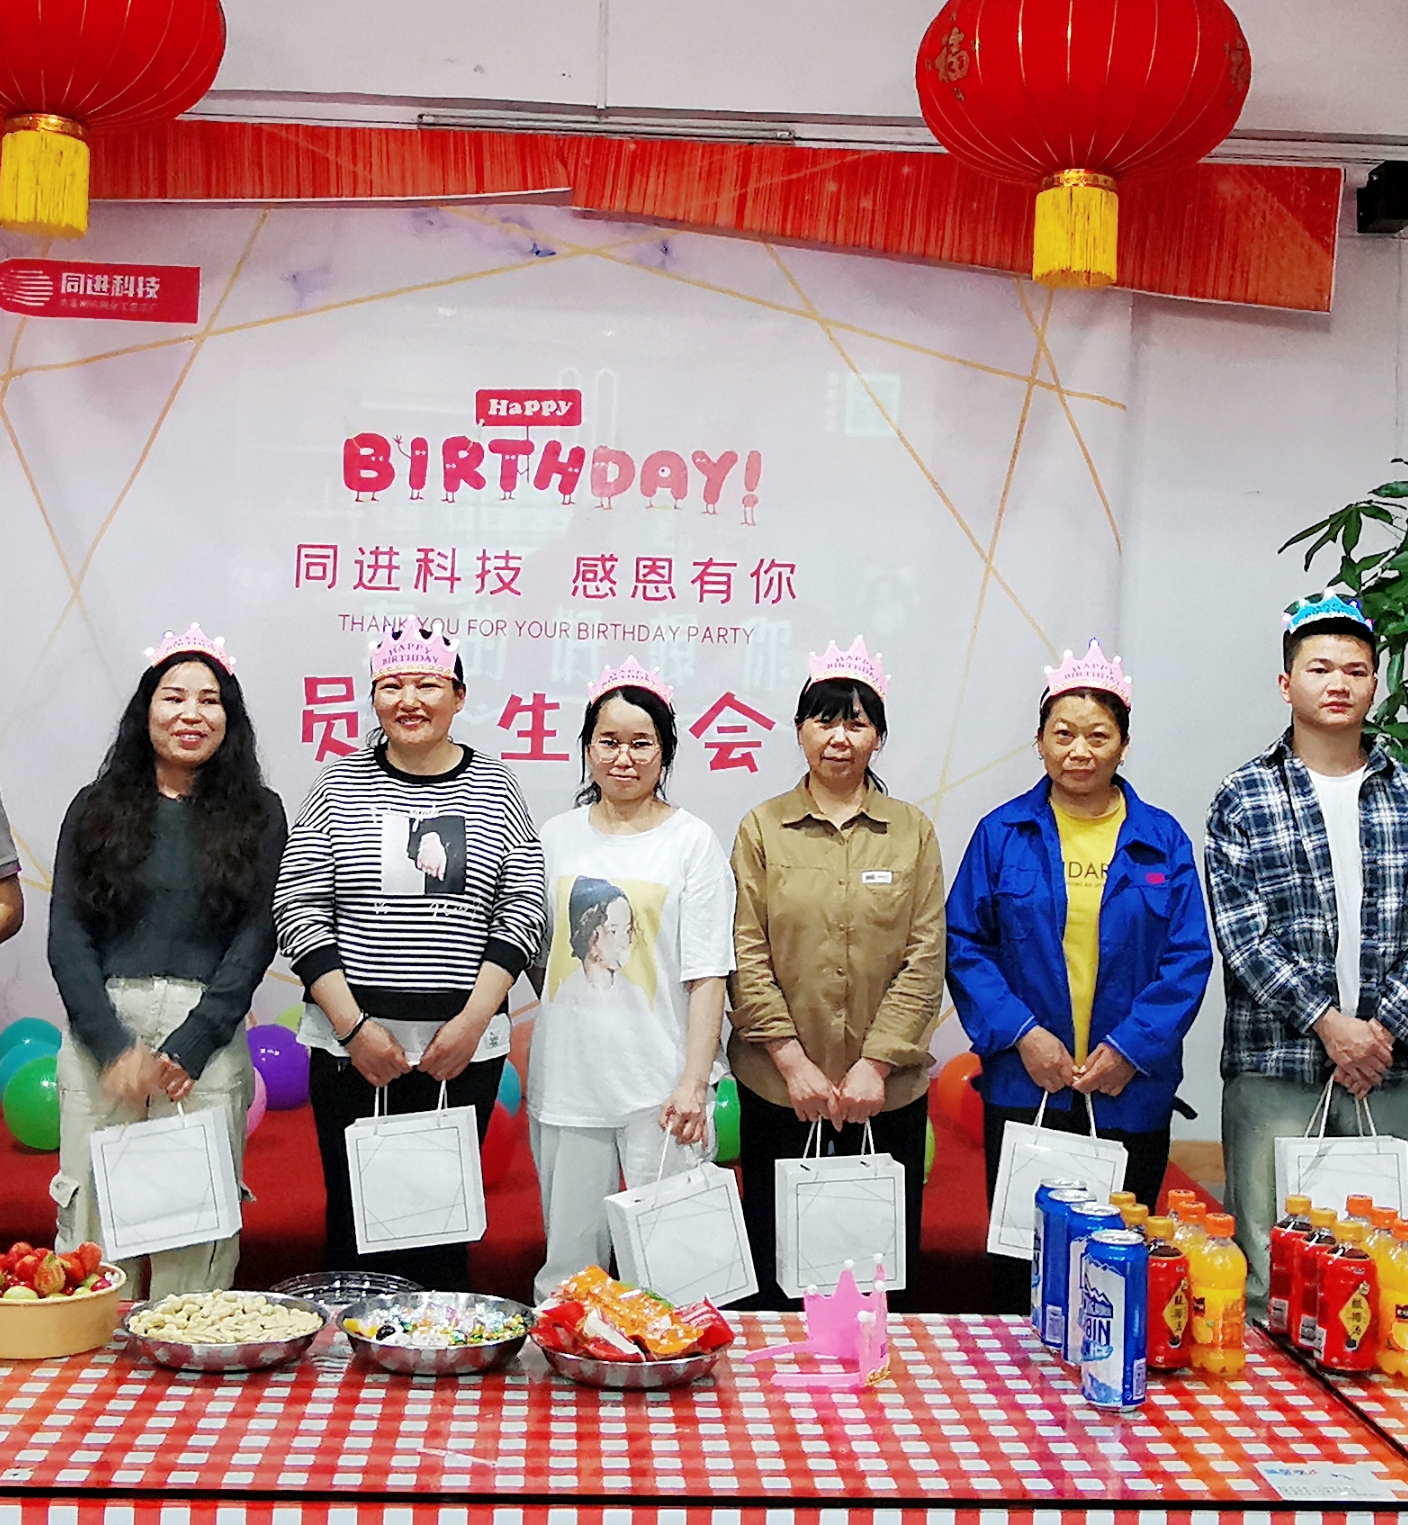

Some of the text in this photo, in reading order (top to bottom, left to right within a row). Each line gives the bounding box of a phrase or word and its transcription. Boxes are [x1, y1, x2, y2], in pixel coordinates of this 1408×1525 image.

[61, 272, 160, 299] 同进科技
[488, 398, 573, 417] Happy
[343, 432, 762, 526] BIRTHDAY!
[295, 544, 797, 604] 同进科技 感恩有你
[468, 619, 507, 637] FOR
[515, 620, 571, 638] YOUR
[577, 622, 680, 642] BIRTHDAY
[687, 626, 755, 645] PARTY
[382, 654, 440, 666] BIRTHDAY
[388, 643, 432, 656] HAPPY
